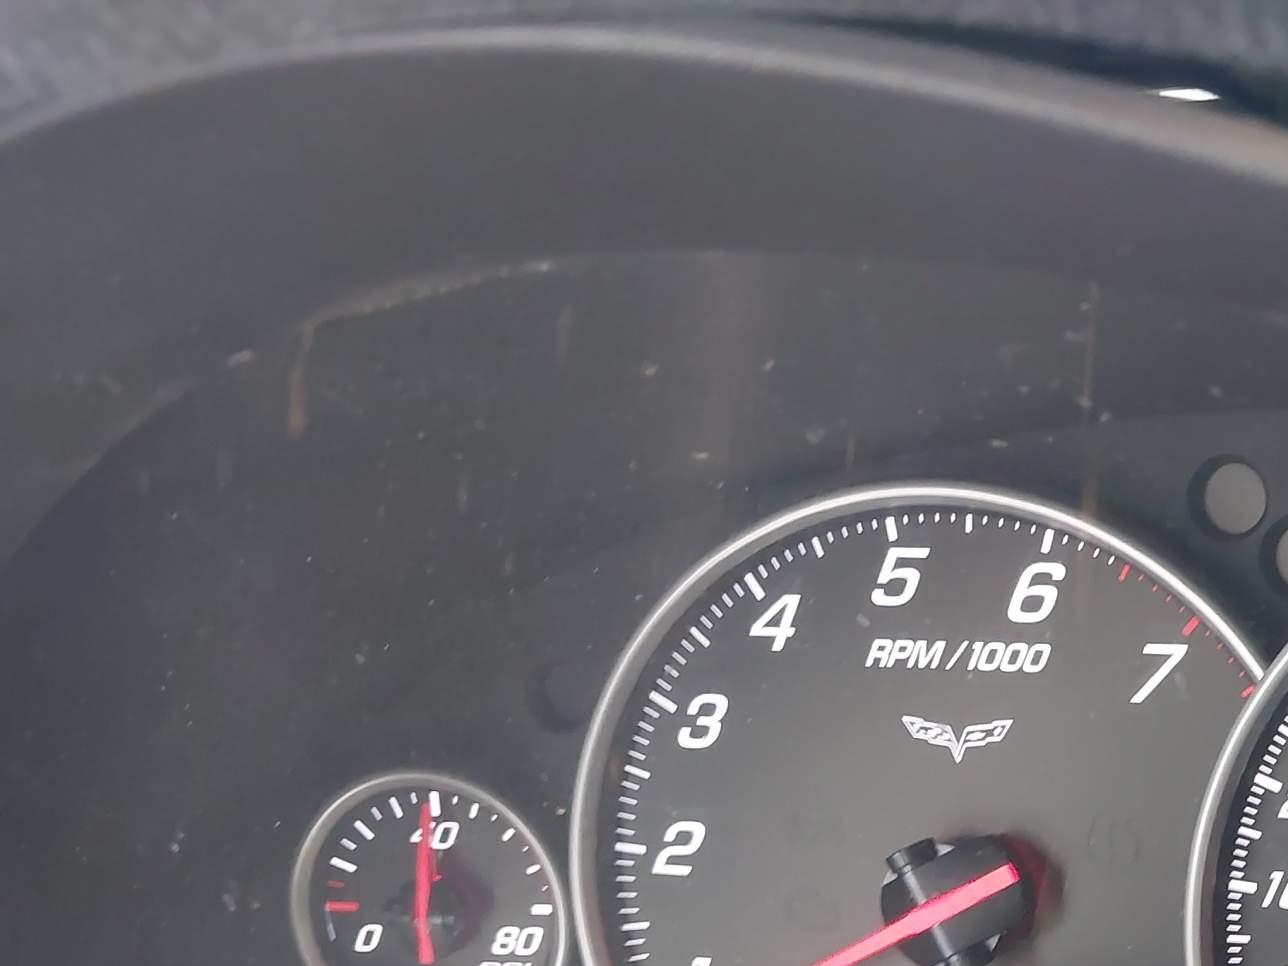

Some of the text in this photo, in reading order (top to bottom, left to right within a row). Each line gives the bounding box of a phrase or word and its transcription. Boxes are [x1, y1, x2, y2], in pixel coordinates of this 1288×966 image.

[870, 546, 931, 607] 5
[1007, 561, 1067, 624] 6
[748, 593, 802, 652] 4
[1129, 643, 1189, 704] 7
[677, 693, 729, 749] 3
[651, 820, 706, 877] 2
[354, 923, 384, 953] 0
[490, 925, 545, 956] 80
